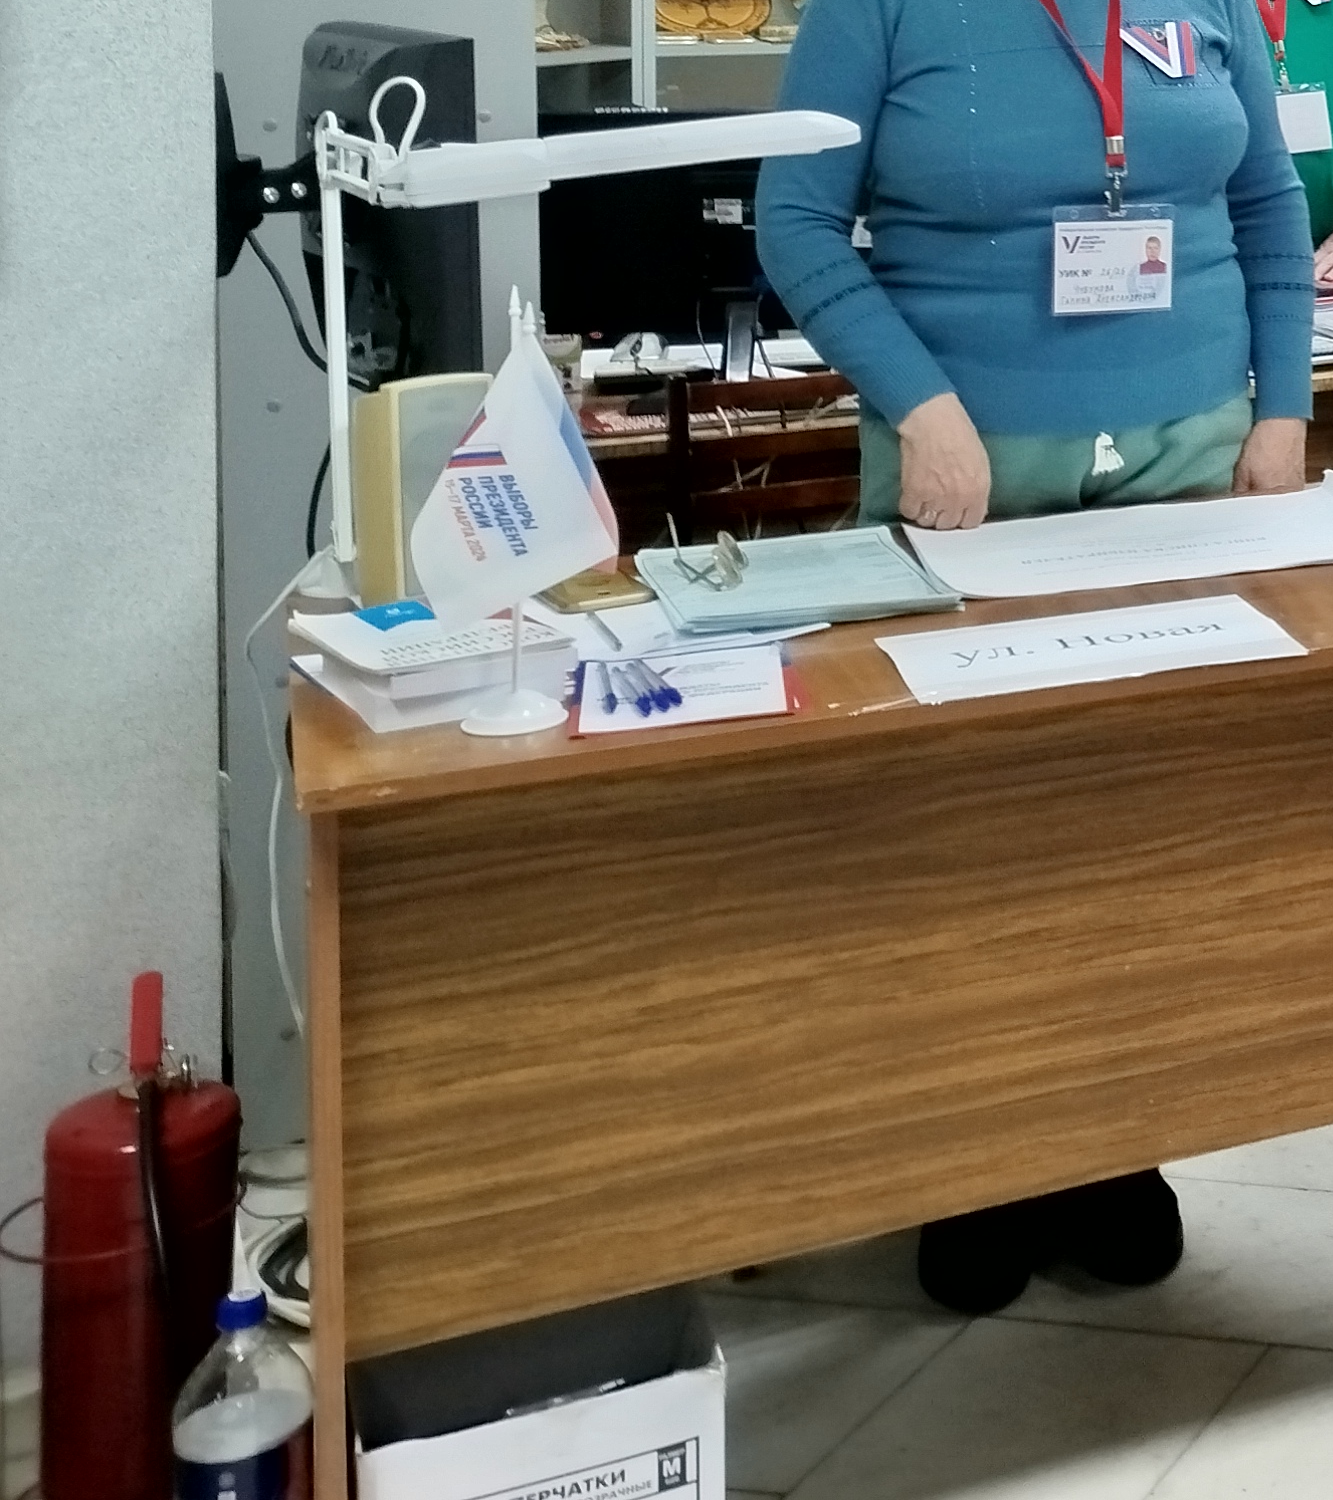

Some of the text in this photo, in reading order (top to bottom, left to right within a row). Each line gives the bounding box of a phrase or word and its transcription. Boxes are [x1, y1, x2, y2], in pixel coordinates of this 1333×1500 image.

[458, 477, 494, 530] РОССИИ
[477, 475, 529, 557] ПРЕЗИДЕНТА
[498, 474, 539, 530] ВЫБОРЫ
[452, 505, 477, 540] МАРТА
[466, 537, 488, 563] 2024
[381, 626, 537, 663] РССИЙСКОЙ
[951, 620, 1226, 670] ул. Новая
[511, 1468, 626, 1500] ЕРЧАТКИ
[577, 1479, 653, 1500] ОЗРАЧНЫЕ
